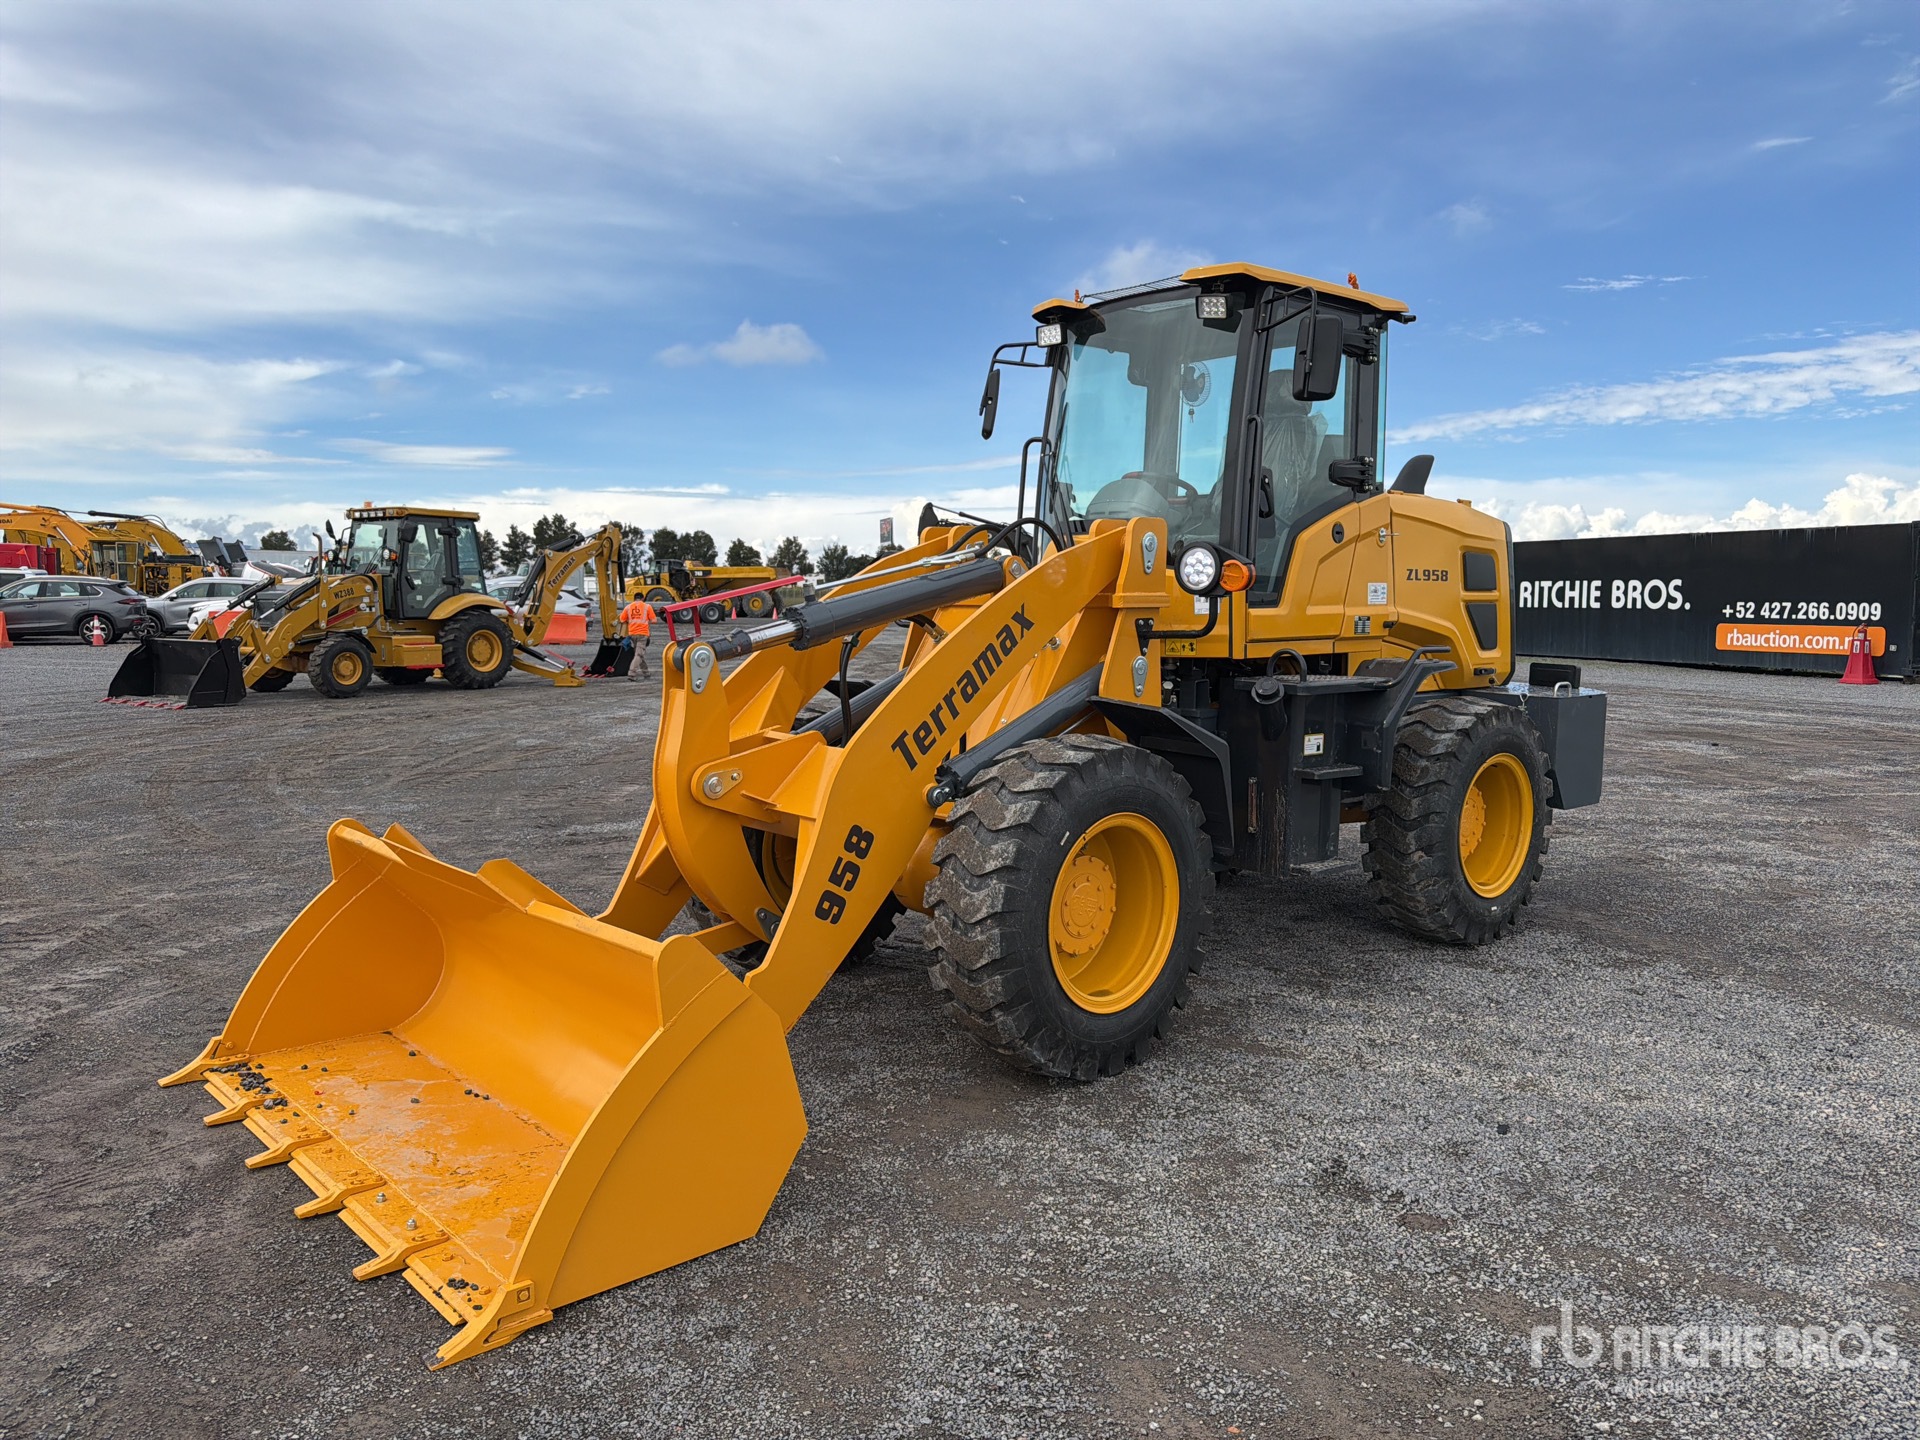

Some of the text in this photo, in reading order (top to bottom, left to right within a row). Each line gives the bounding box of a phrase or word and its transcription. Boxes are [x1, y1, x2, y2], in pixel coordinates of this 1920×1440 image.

[548, 556, 576, 588] Terramax
[1406, 568, 1448, 582] ZL958
[1519, 579, 1691, 610] RITCHIE BROS.
[1722, 602, 1882, 621] +52 427.266.0909
[891, 602, 1035, 772] Terramax
[814, 824, 874, 924] 958
